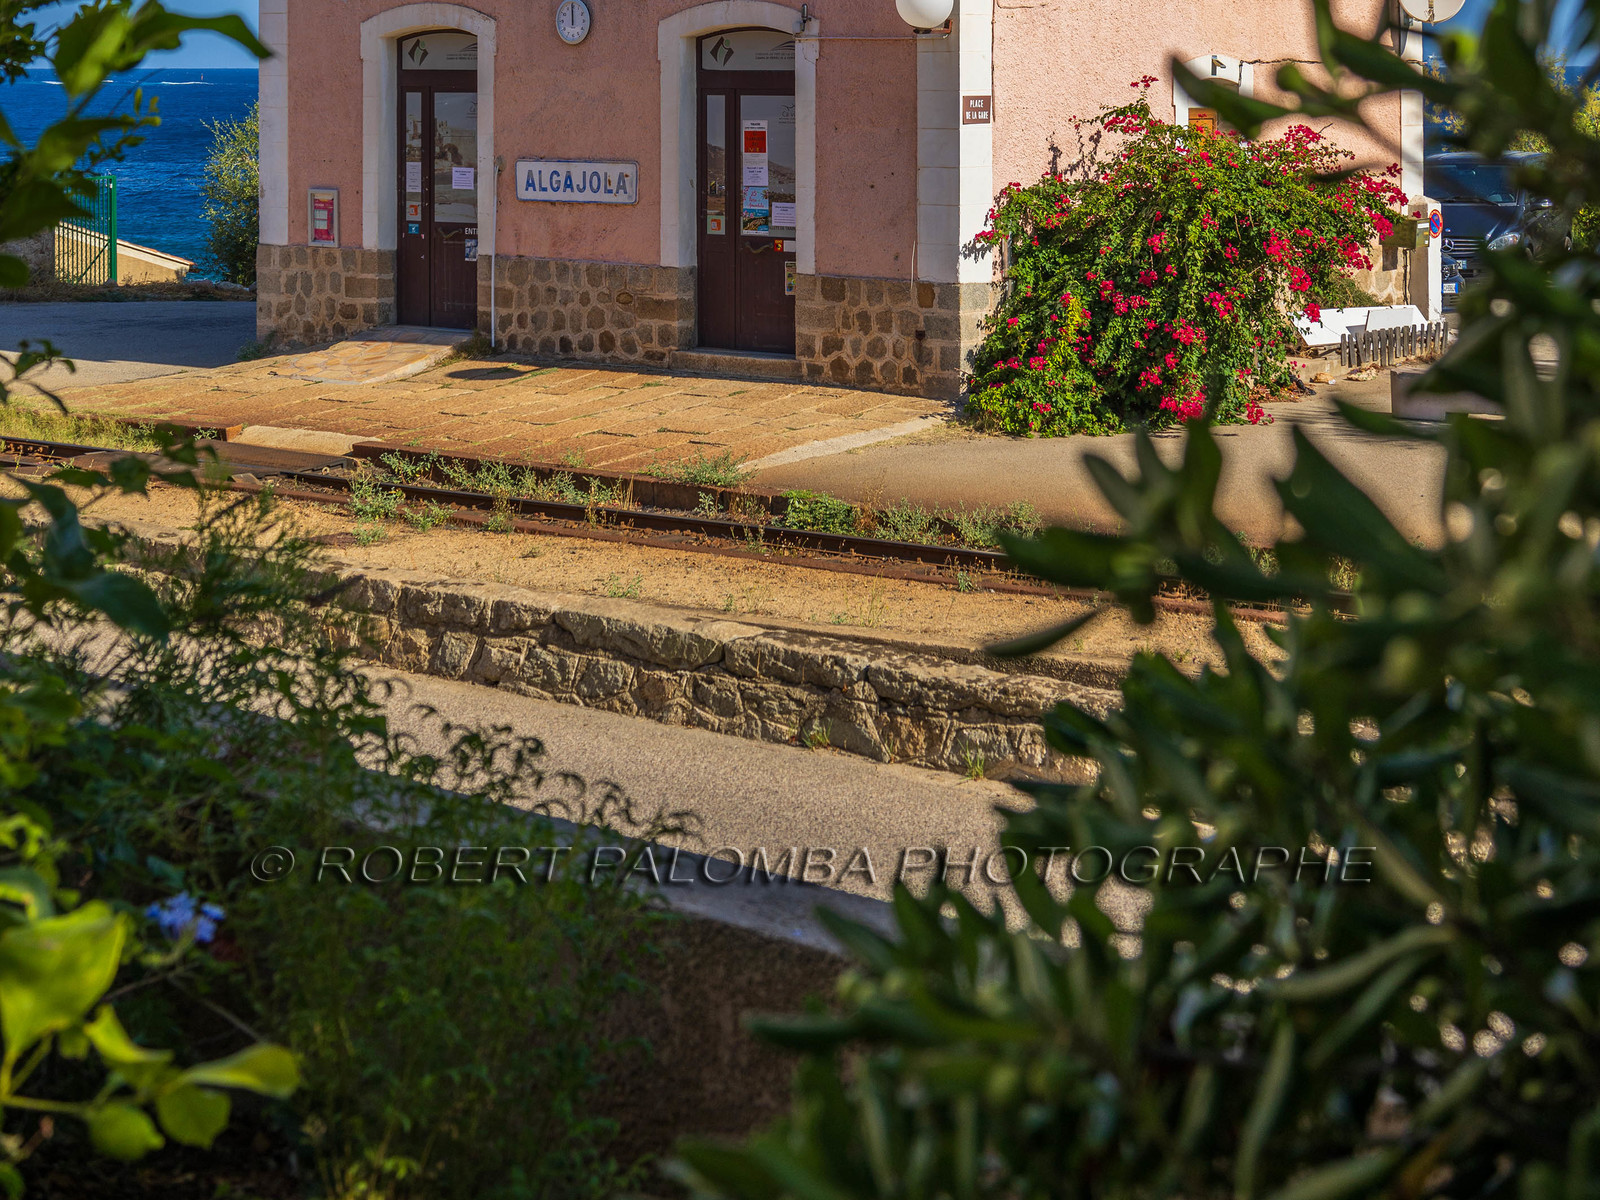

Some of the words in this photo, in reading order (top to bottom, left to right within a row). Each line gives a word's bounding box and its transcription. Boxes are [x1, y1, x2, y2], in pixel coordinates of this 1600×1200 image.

[969, 99, 984, 108] PLACE
[965, 111, 971, 120] DE
[971, 111, 978, 120] LA
[978, 111, 989, 120] GARE
[525, 169, 628, 195] ALGAJOLA
[465, 227, 478, 235] ENT
